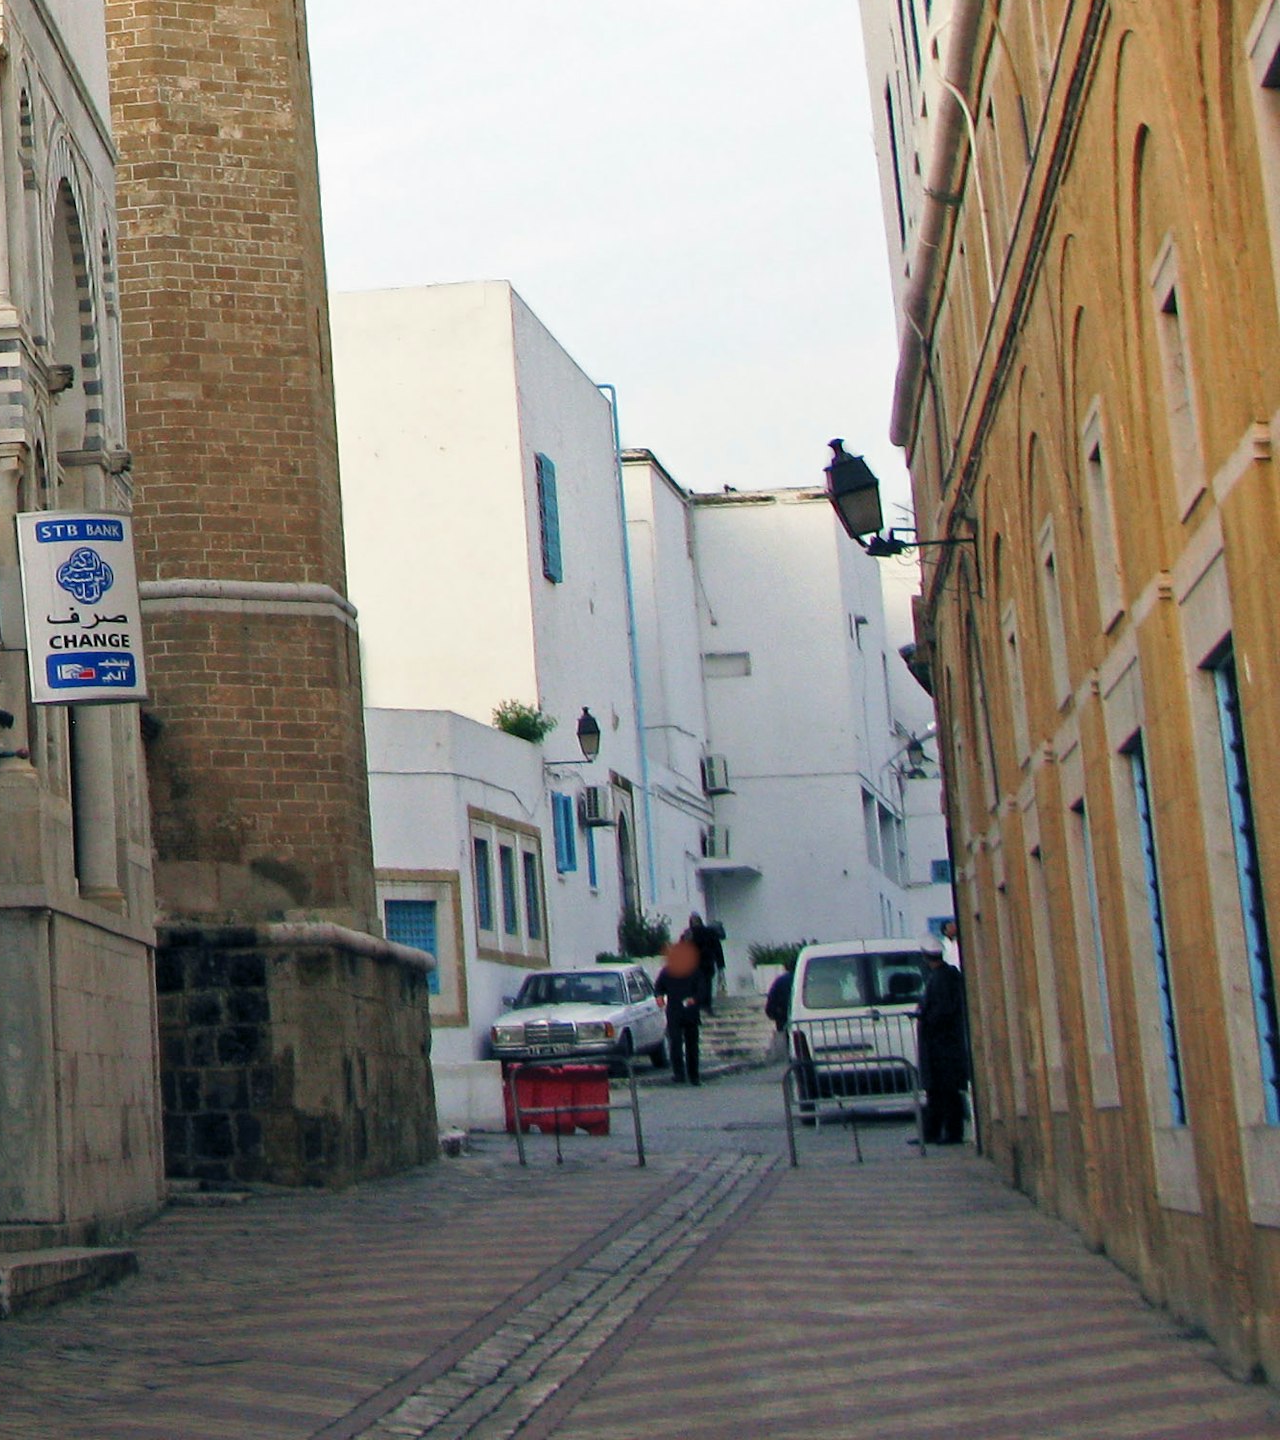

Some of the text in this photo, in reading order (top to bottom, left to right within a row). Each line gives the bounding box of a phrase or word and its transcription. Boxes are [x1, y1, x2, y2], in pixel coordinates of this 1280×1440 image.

[41, 524, 121, 539] STB BANK
[46, 607, 129, 629] صرف
[48, 633, 131, 650] CHANGE
